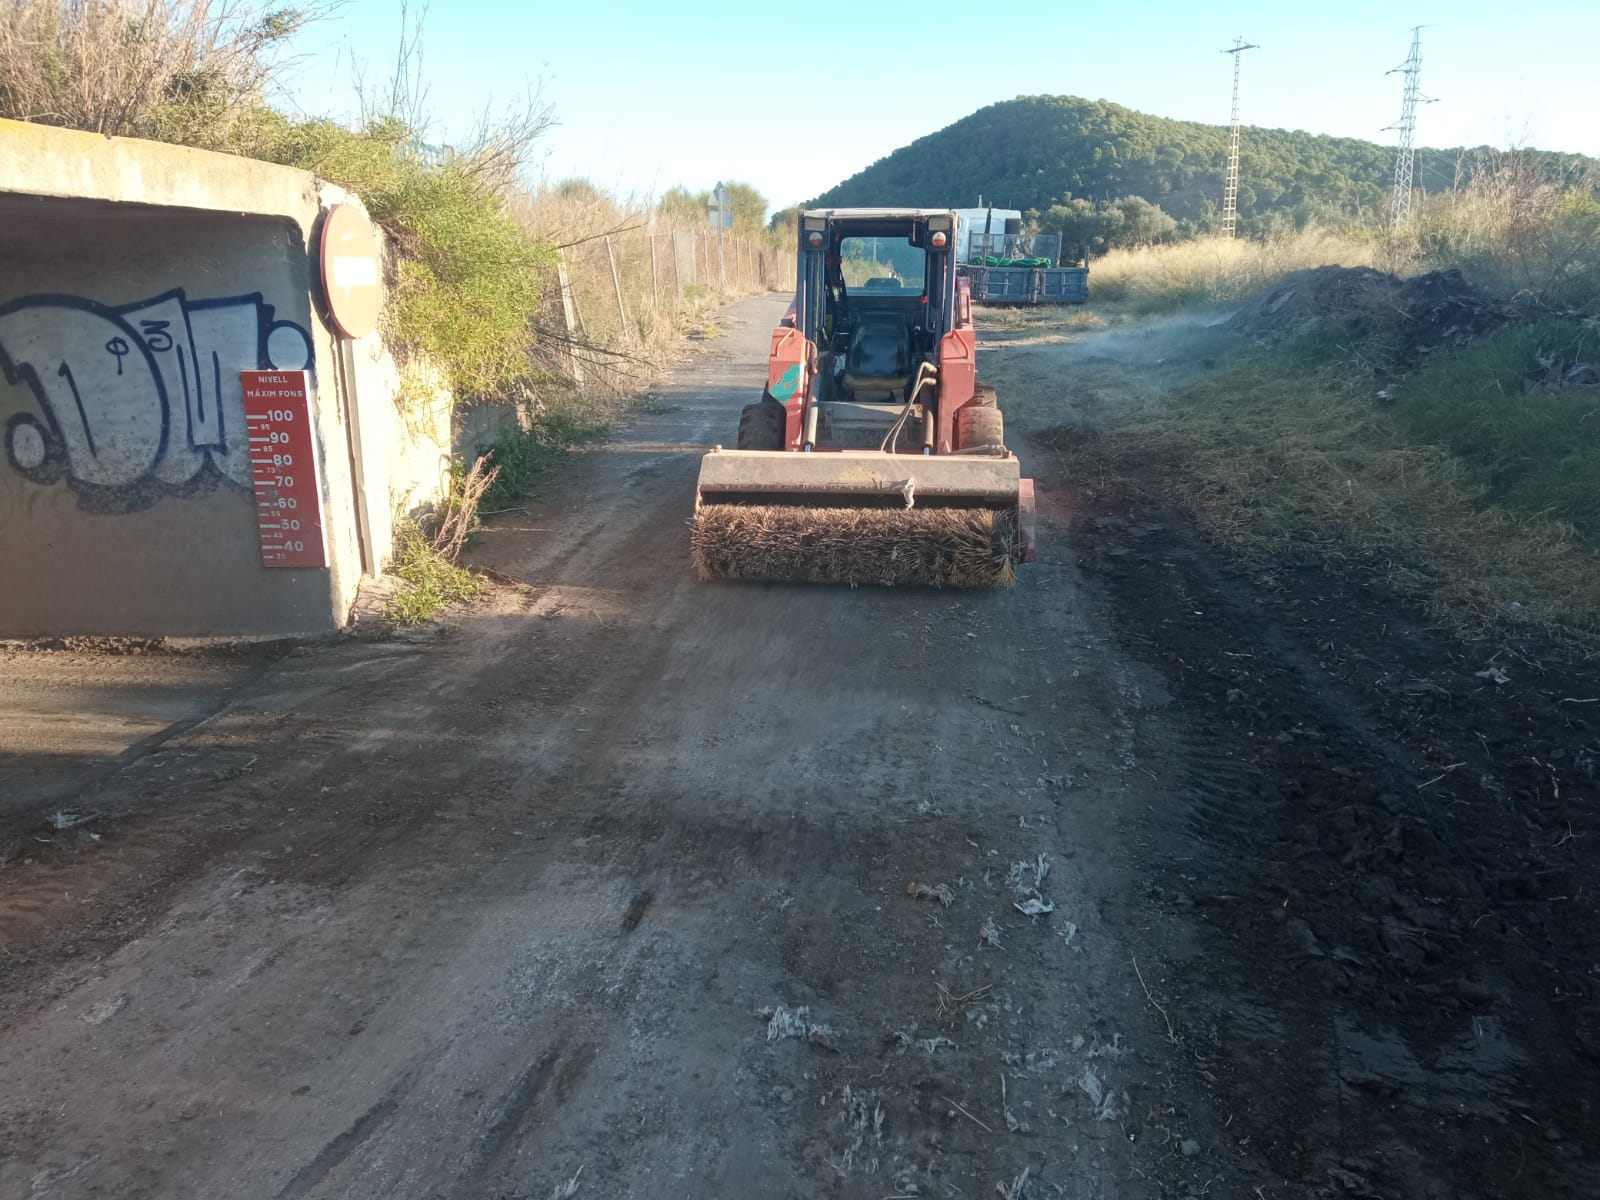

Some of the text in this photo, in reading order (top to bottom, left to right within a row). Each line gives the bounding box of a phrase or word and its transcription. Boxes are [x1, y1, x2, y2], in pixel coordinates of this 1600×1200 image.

[258, 375, 289, 383] NIVELL
[278, 390, 304, 398] FONS
[267, 409, 294, 422] 100
[270, 431, 290, 444] 90
[273, 454, 293, 466] 80
[275, 475, 294, 487] 70
[278, 497, 297, 509] 60
[280, 518, 300, 530] 50
[284, 540, 304, 552] 40
